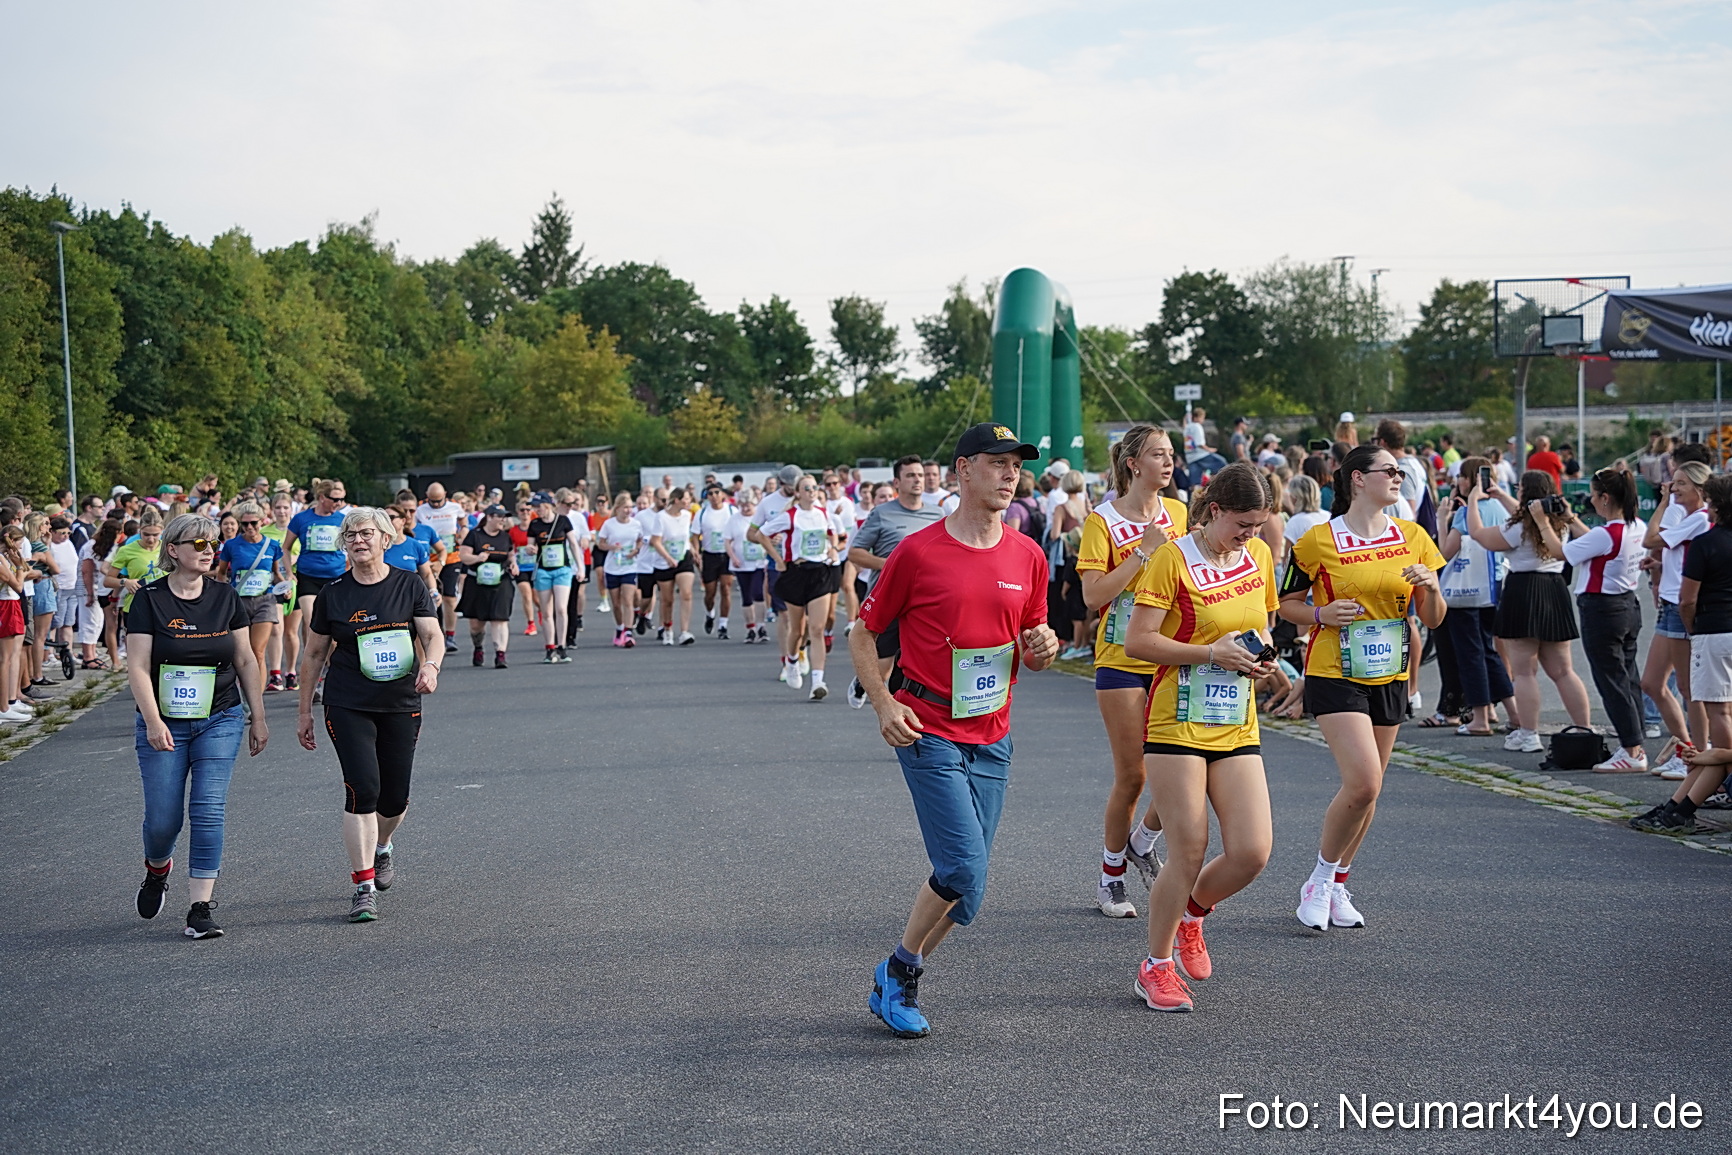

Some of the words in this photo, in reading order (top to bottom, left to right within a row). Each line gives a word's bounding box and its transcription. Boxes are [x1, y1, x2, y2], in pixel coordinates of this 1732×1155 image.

[1339, 553, 1373, 566] MAX
[1376, 547, 1410, 560] BÖGL
[997, 581, 1023, 591] Thomas
[1202, 589, 1234, 606] MAX
[1234, 576, 1265, 596] BÖGL
[349, 610, 368, 623] 45
[167, 618, 187, 630] 45
[367, 623, 390, 631] solidem
[1362, 643, 1392, 656] 1804
[375, 651, 397, 663] 188
[976, 675, 996, 691] 66
[174, 687, 197, 699] 193
[1205, 684, 1237, 699] 1756
[960, 694, 984, 702] Thomas
[1204, 700, 1221, 708] Paula
